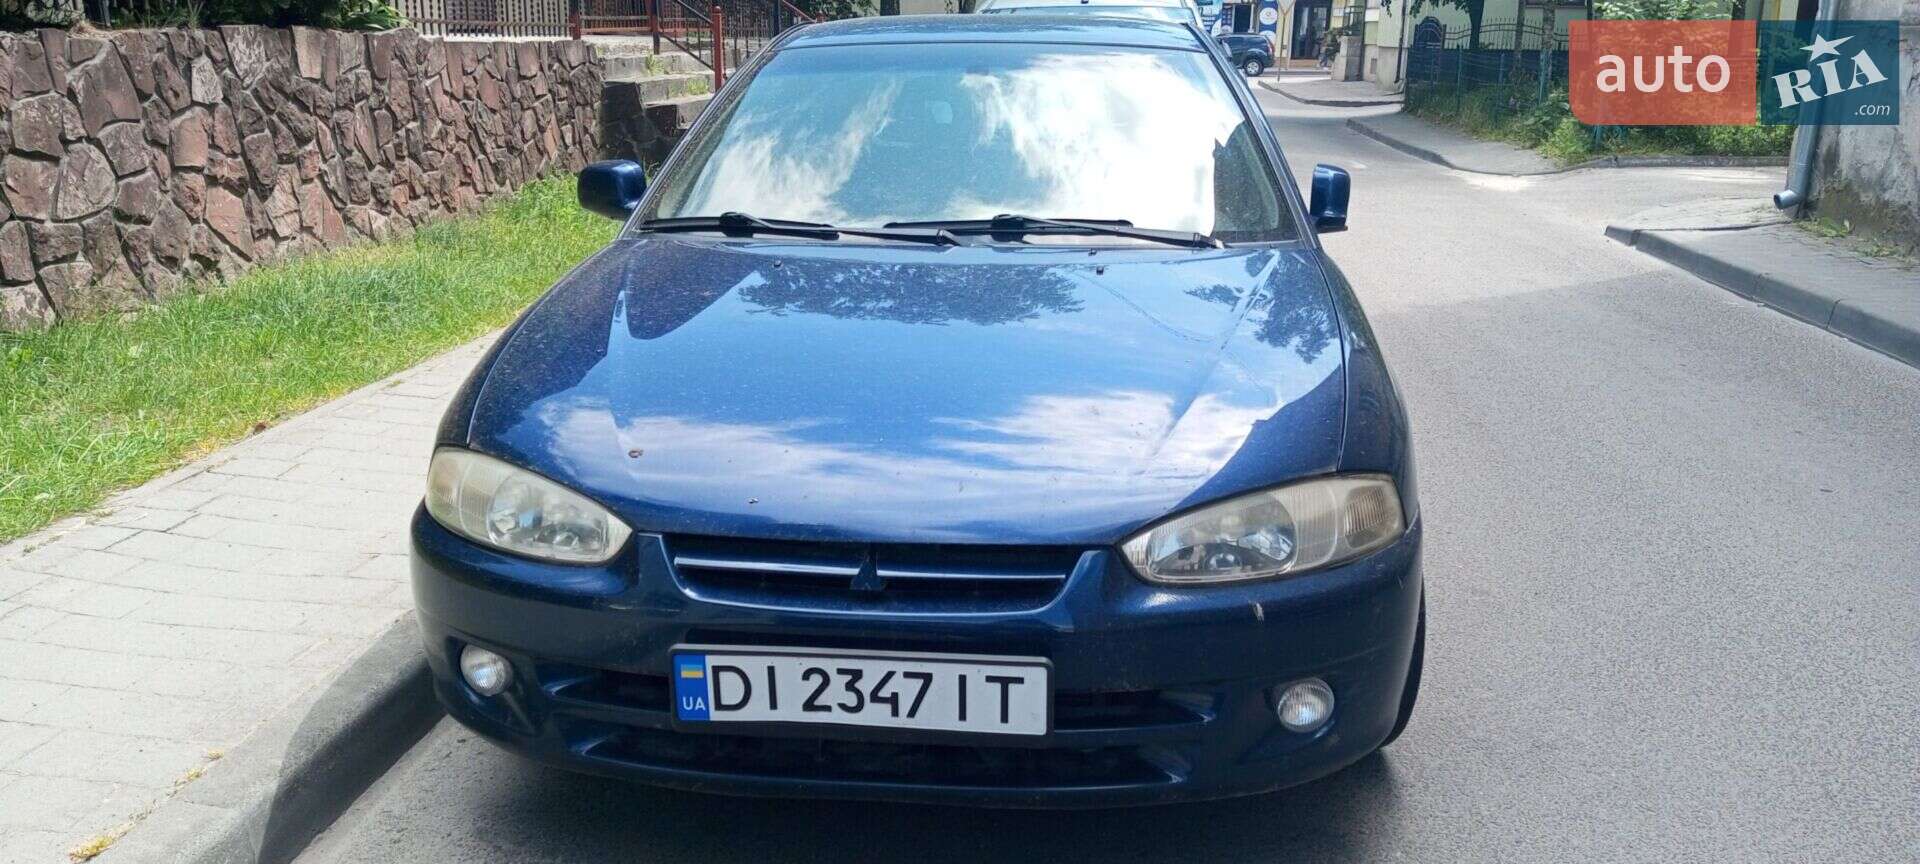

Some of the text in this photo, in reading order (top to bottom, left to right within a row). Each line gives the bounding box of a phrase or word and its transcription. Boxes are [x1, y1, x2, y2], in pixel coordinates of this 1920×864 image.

[682, 697, 706, 711] UA
[711, 665, 1024, 723] DI 2347 IT
